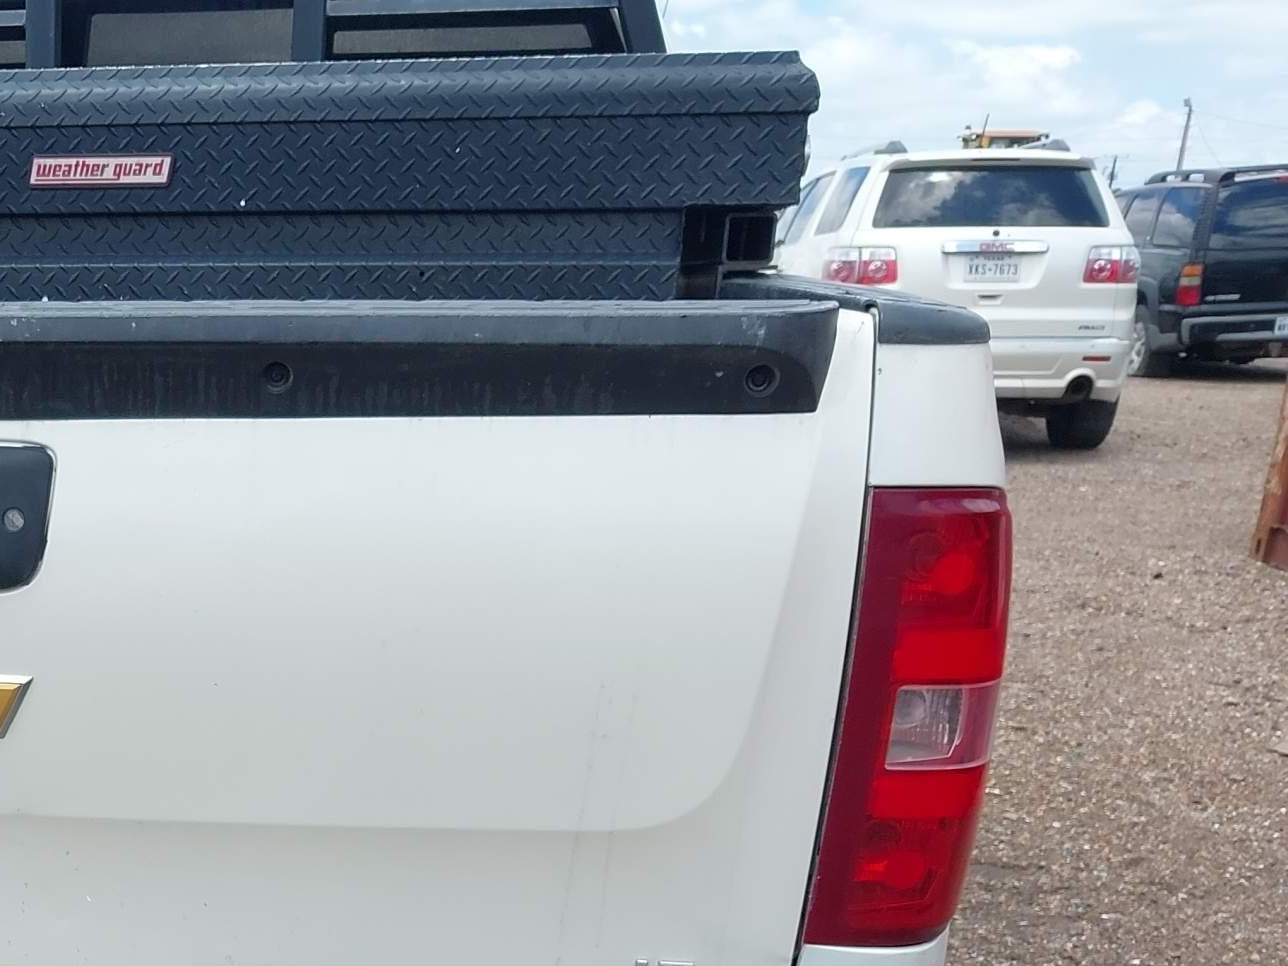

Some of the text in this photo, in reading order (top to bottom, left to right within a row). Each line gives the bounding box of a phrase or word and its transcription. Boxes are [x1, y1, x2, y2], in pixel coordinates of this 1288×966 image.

[35, 159, 165, 180] weather guard
[979, 242, 1015, 253] GMC
